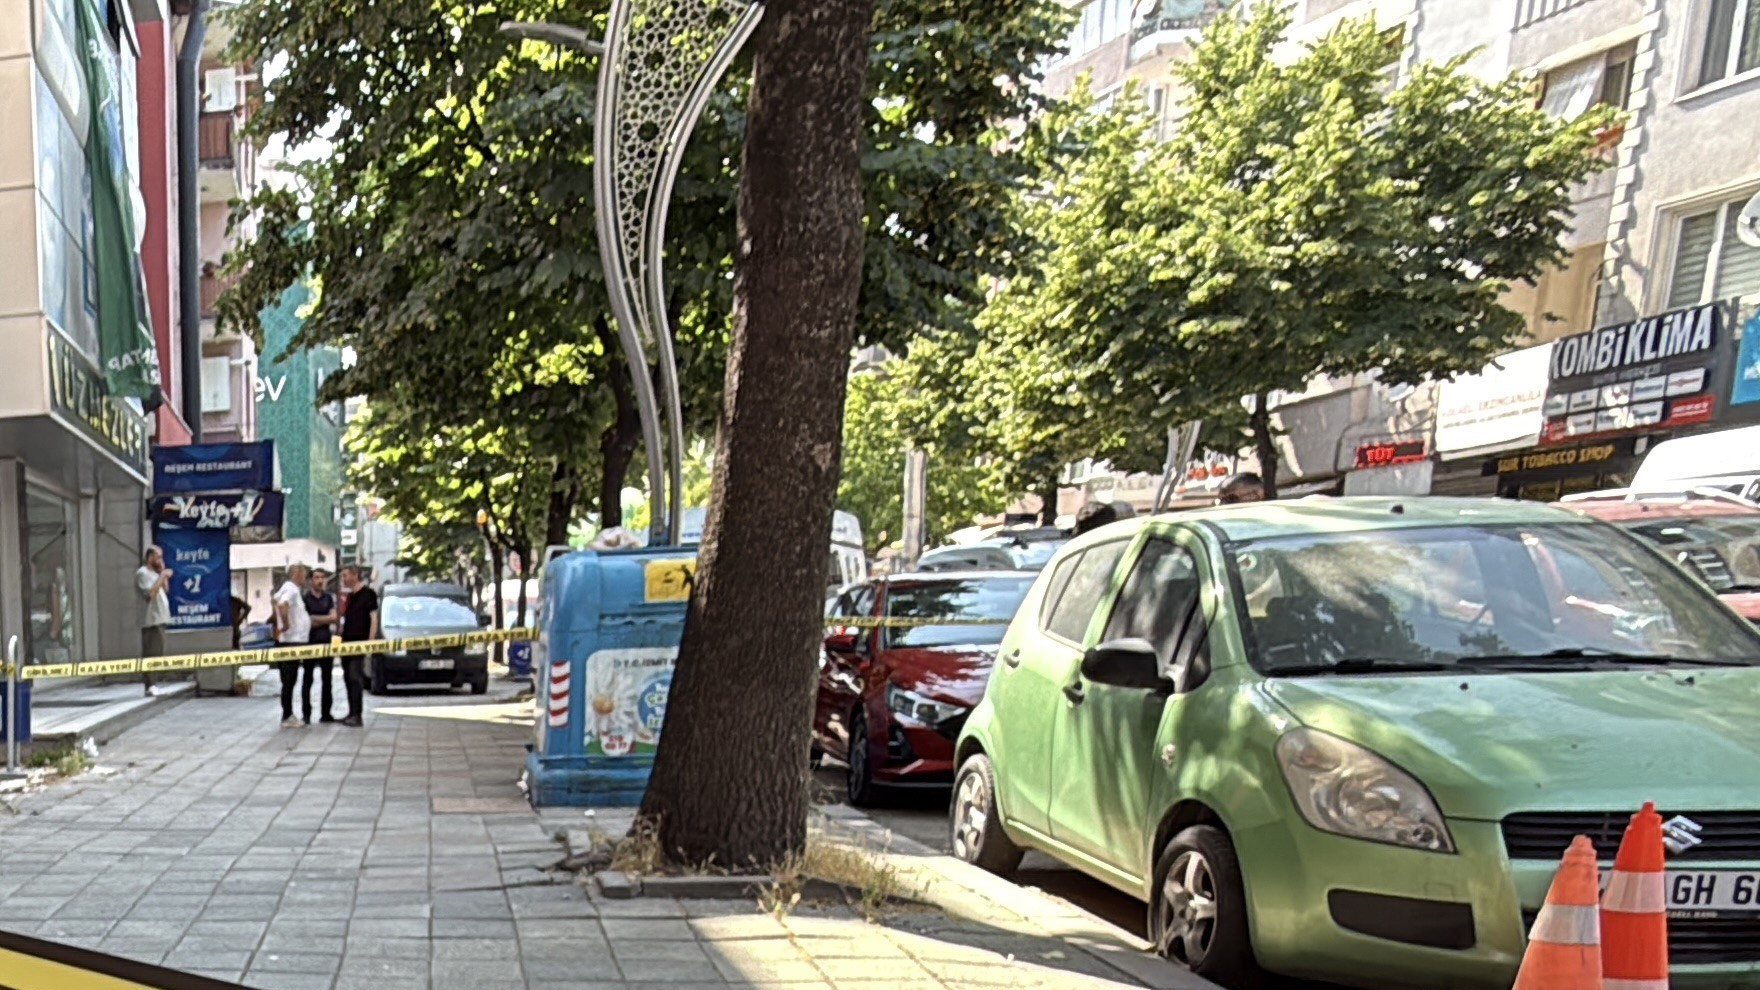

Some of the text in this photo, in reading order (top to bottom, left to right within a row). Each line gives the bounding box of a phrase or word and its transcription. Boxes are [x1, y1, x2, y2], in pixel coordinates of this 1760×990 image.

[1578, 444, 1615, 462] SHOP
[1672, 874, 1760, 905] GH 6
